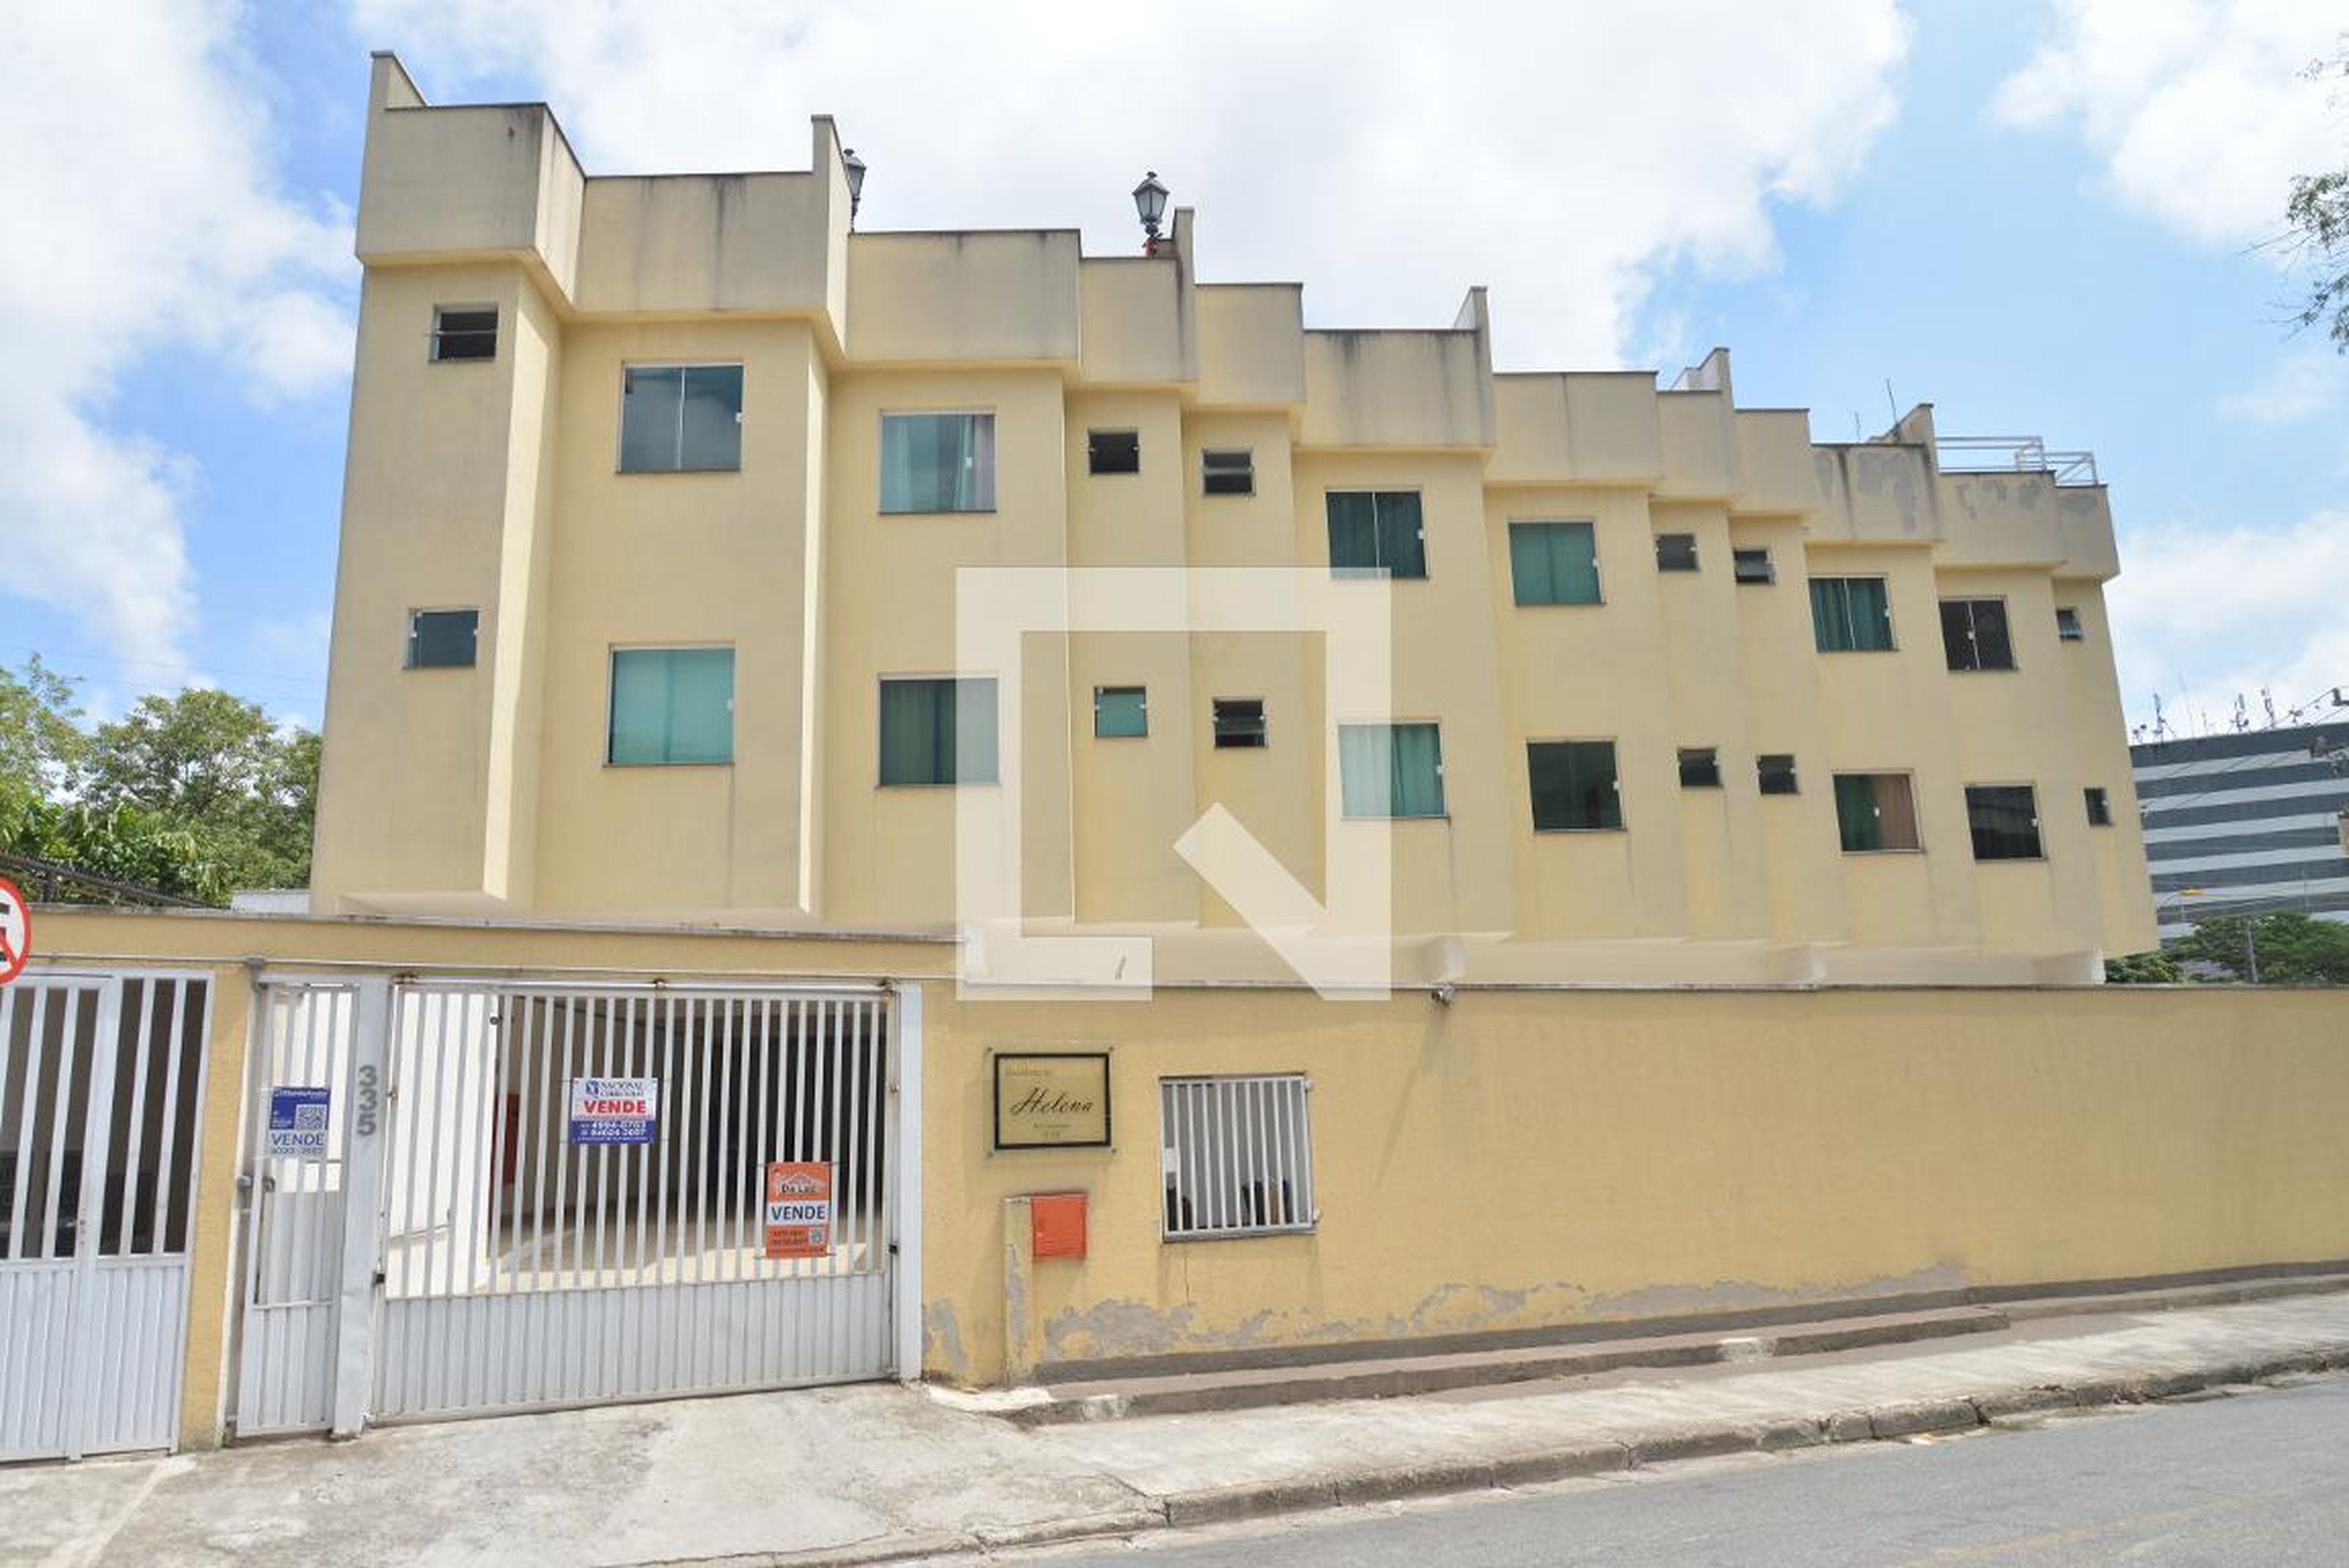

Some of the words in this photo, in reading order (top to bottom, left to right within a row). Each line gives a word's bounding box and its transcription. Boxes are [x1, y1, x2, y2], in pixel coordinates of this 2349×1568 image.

[358, 1065, 377, 1136] 335
[584, 1100, 647, 1114] VENDE
[1011, 1087, 1094, 1116] Helena
[271, 1133, 324, 1146] VENDE
[771, 1205, 826, 1221] VENDE
